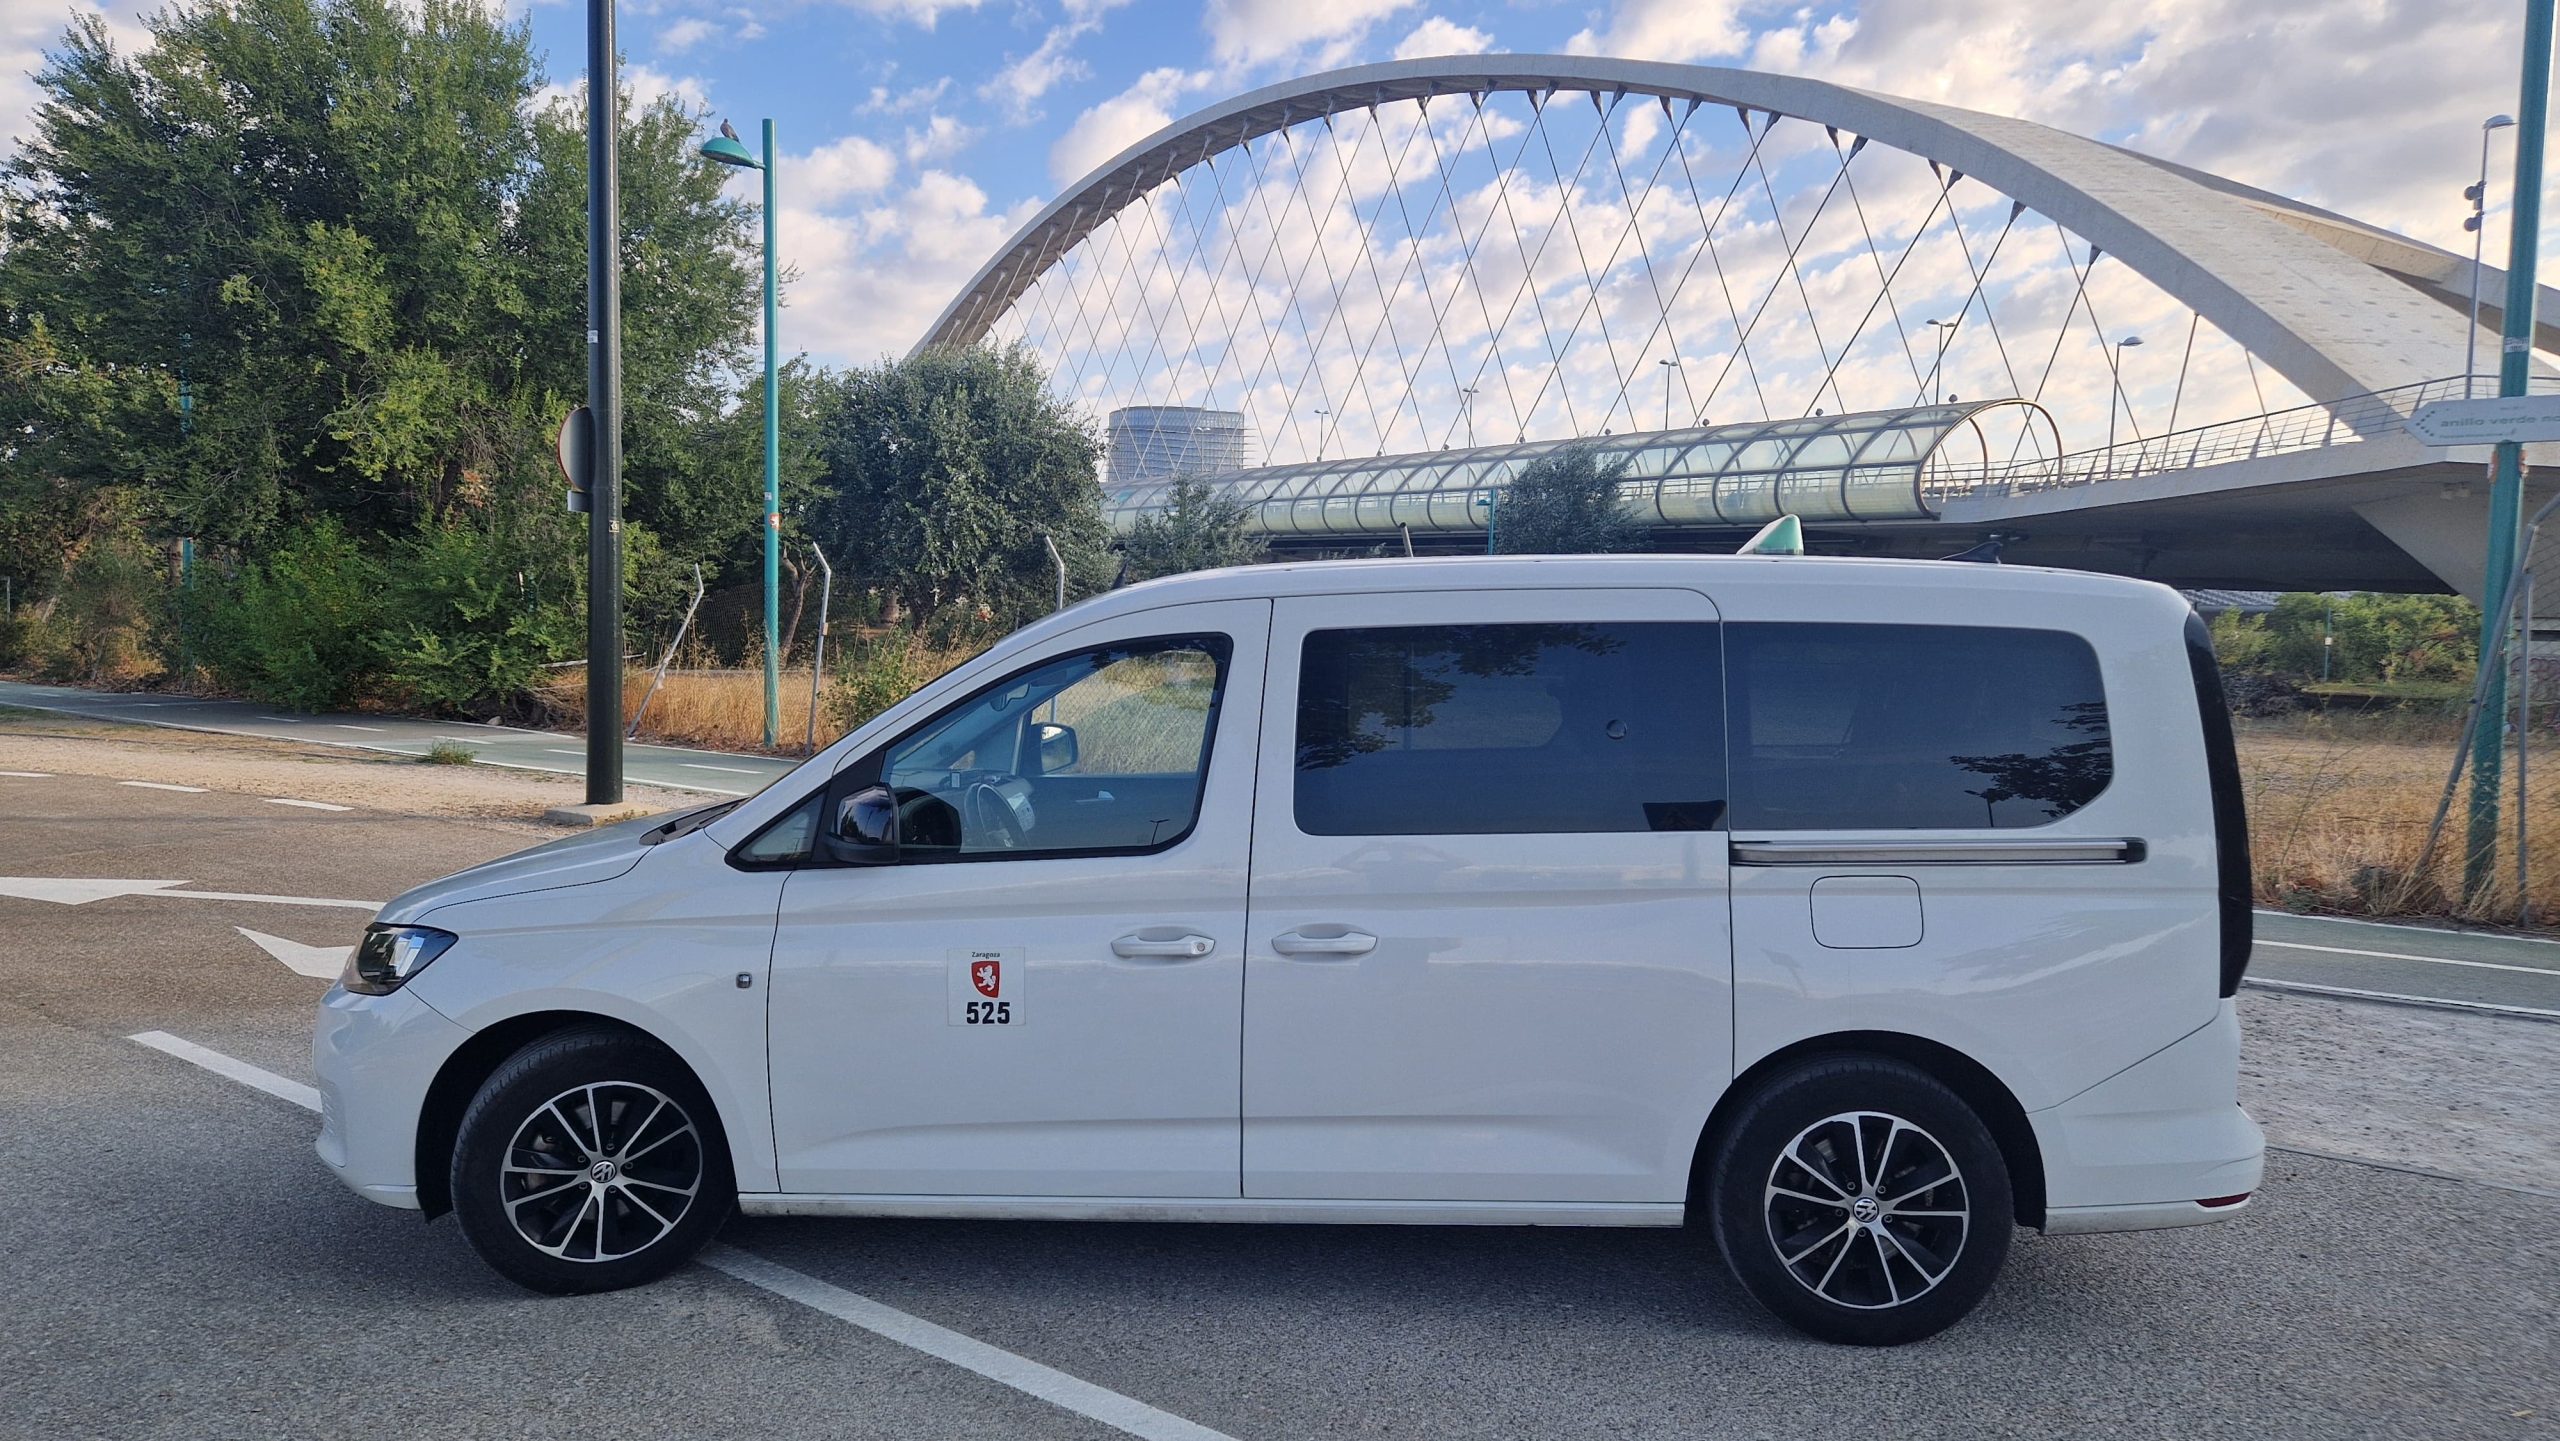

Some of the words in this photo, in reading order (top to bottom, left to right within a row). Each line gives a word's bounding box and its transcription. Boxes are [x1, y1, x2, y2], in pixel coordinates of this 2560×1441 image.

[2440, 417, 2485, 427] anillo
[2488, 415, 2537, 425] verde
[971, 951, 1001, 960] Zaragoza
[966, 1001, 1011, 1024] 525
